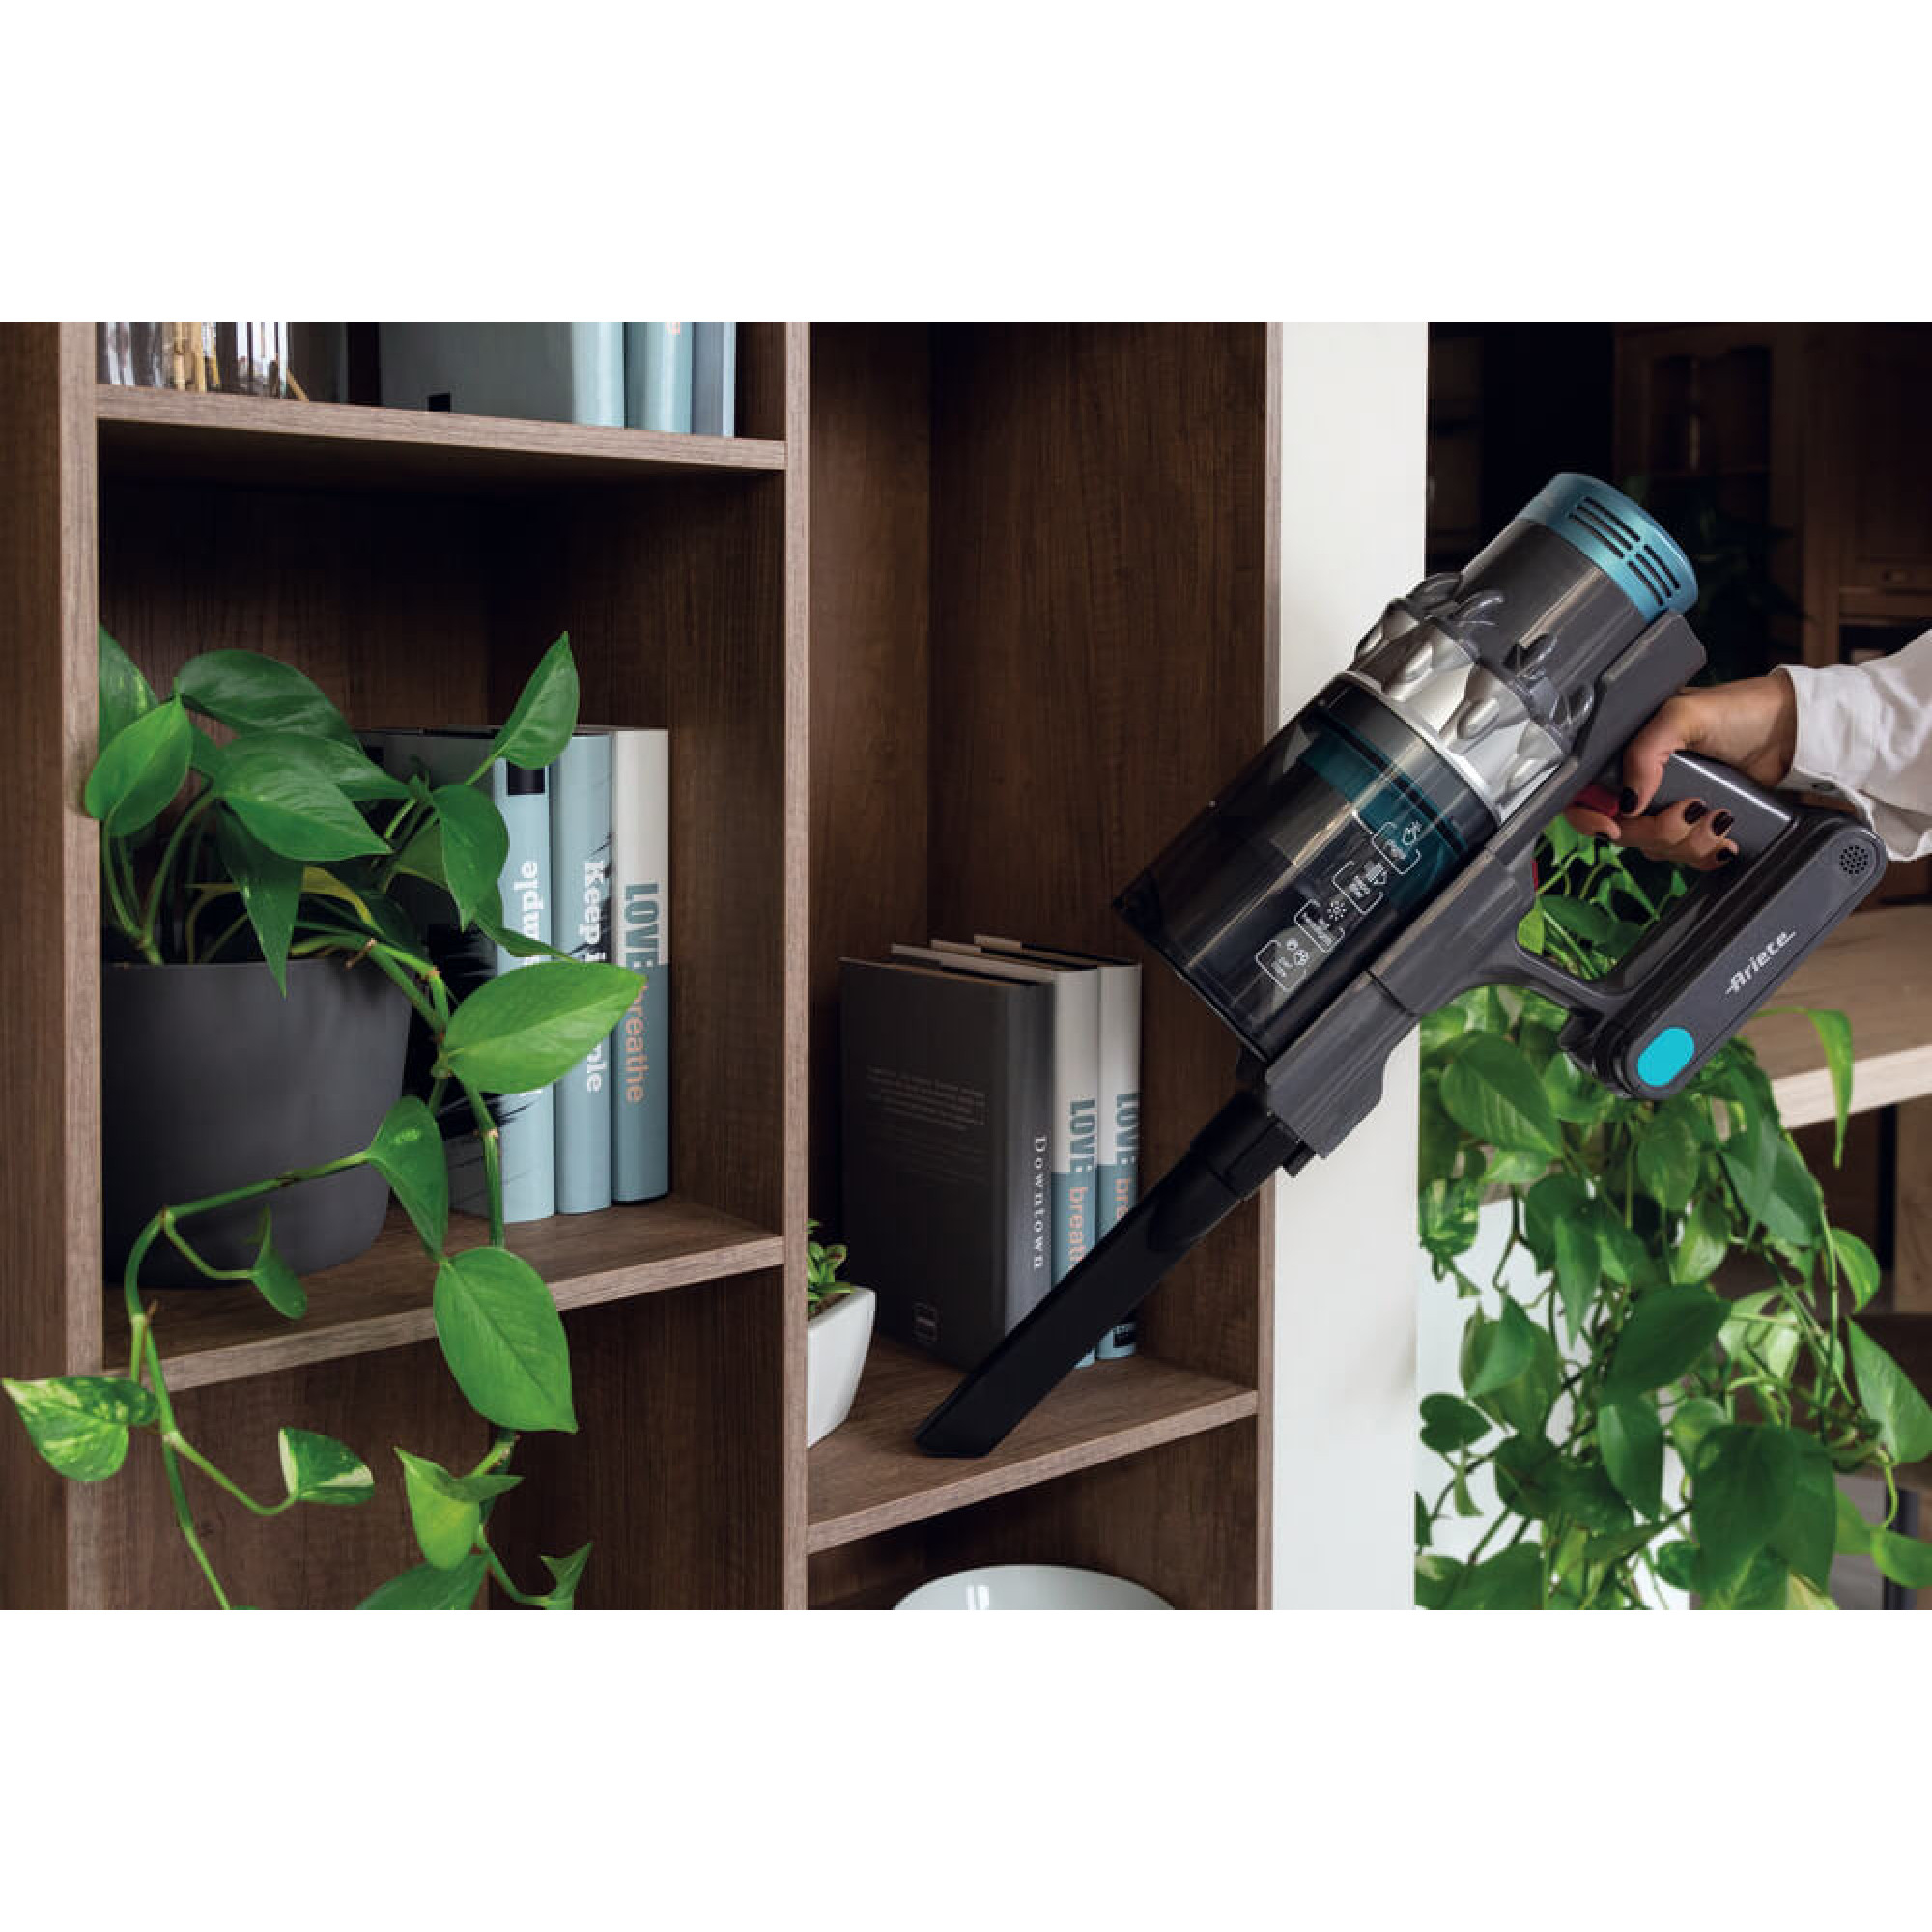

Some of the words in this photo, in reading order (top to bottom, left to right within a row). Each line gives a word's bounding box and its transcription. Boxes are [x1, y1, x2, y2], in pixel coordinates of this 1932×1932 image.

[514, 861, 543, 966] mple
[580, 861, 604, 944] Keep
[625, 883, 659, 969] LOVE
[1725, 931, 1796, 995] Ariete
[1034, 1135, 1047, 1270] Downtown
